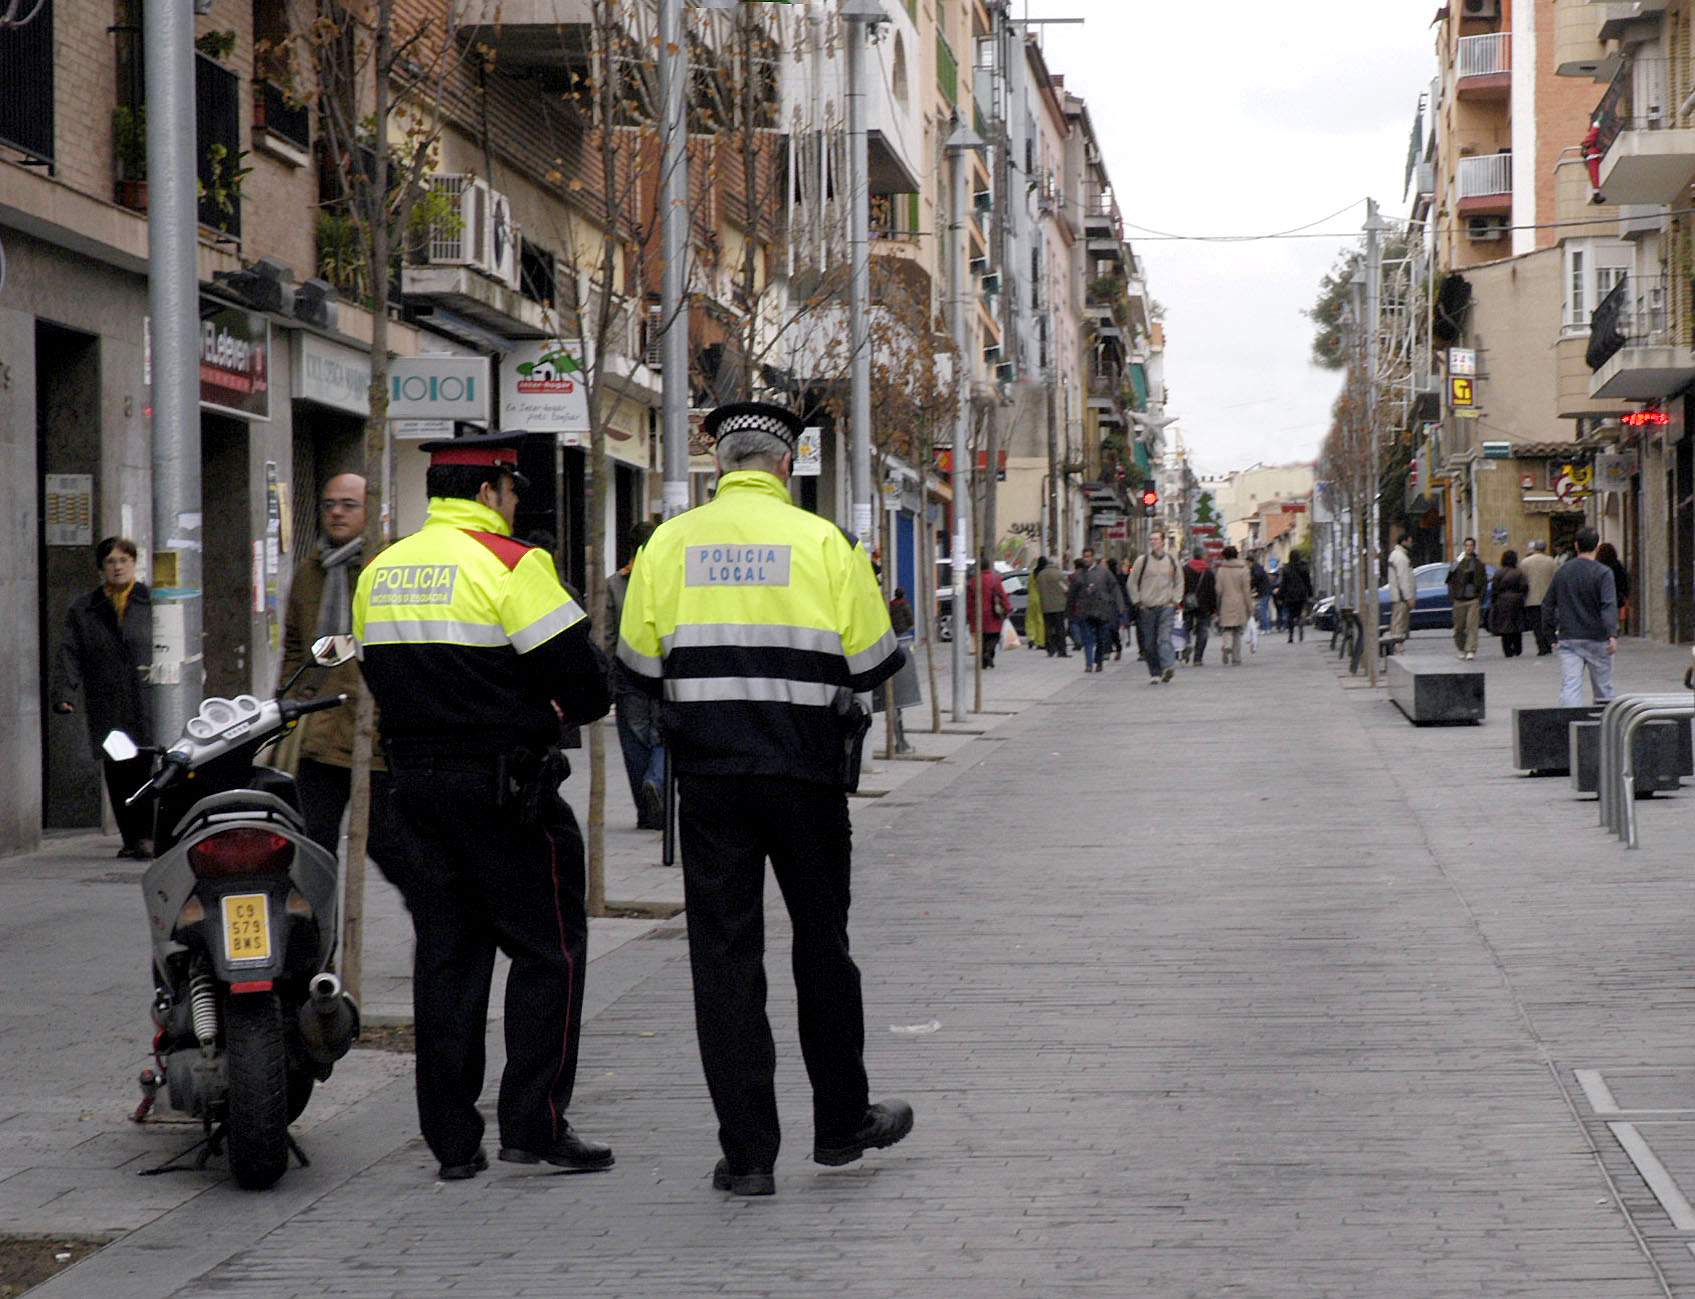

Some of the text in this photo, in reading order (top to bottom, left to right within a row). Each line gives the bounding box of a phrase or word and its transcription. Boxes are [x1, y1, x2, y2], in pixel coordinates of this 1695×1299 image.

[700, 549, 775, 563] POLICIA
[373, 567, 451, 589] POLICIA
[709, 566, 766, 581] LOCAL
[236, 904, 255, 918] C9
[232, 920, 261, 934] 579
